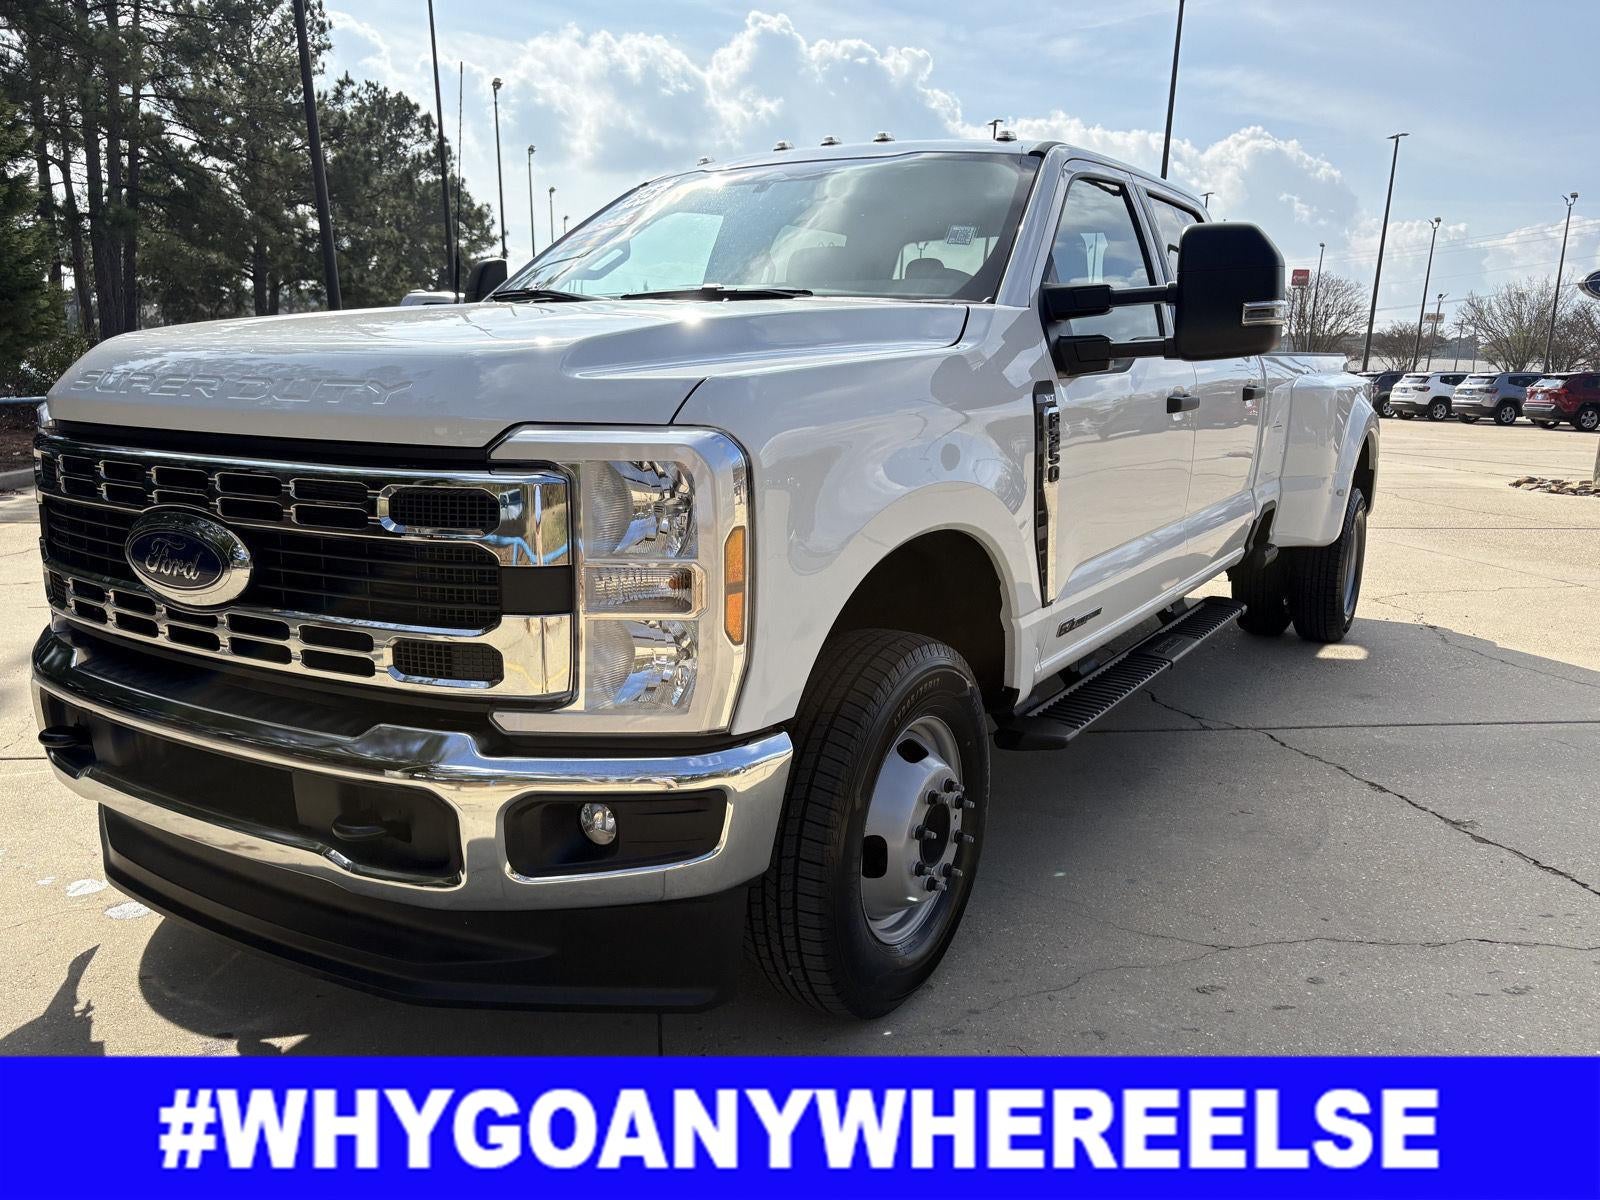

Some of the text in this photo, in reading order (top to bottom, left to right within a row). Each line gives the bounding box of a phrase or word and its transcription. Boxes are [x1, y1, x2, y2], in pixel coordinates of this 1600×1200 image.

[71, 369, 413, 405] SUPER DUTY
[145, 538, 201, 580] Ford
